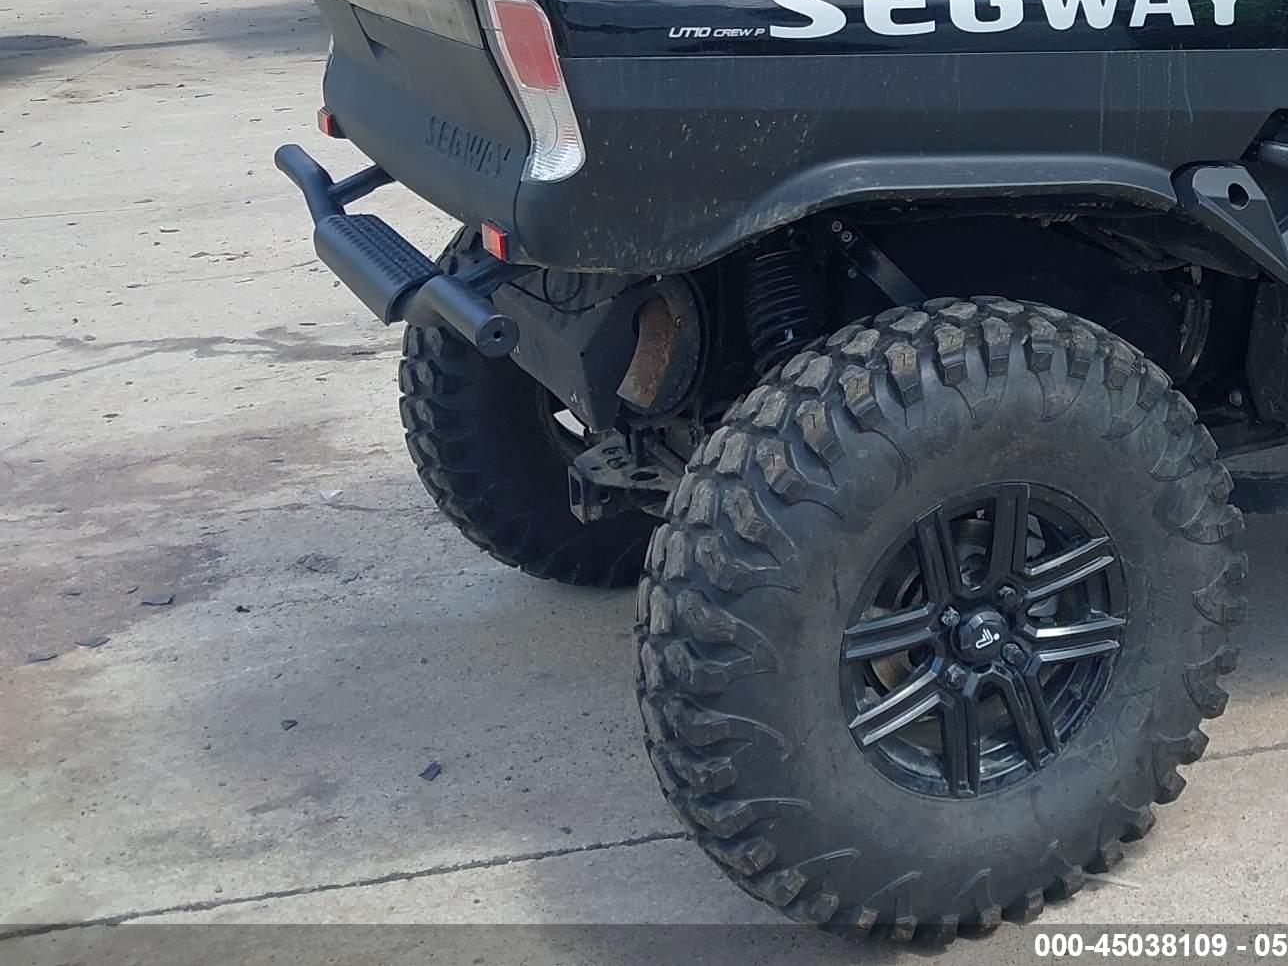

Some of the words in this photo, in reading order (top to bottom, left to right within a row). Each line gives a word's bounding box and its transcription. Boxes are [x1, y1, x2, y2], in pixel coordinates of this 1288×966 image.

[712, 28, 754, 38] CREW
[754, 28, 765, 37] P
[424, 115, 511, 180] SEGWAY
